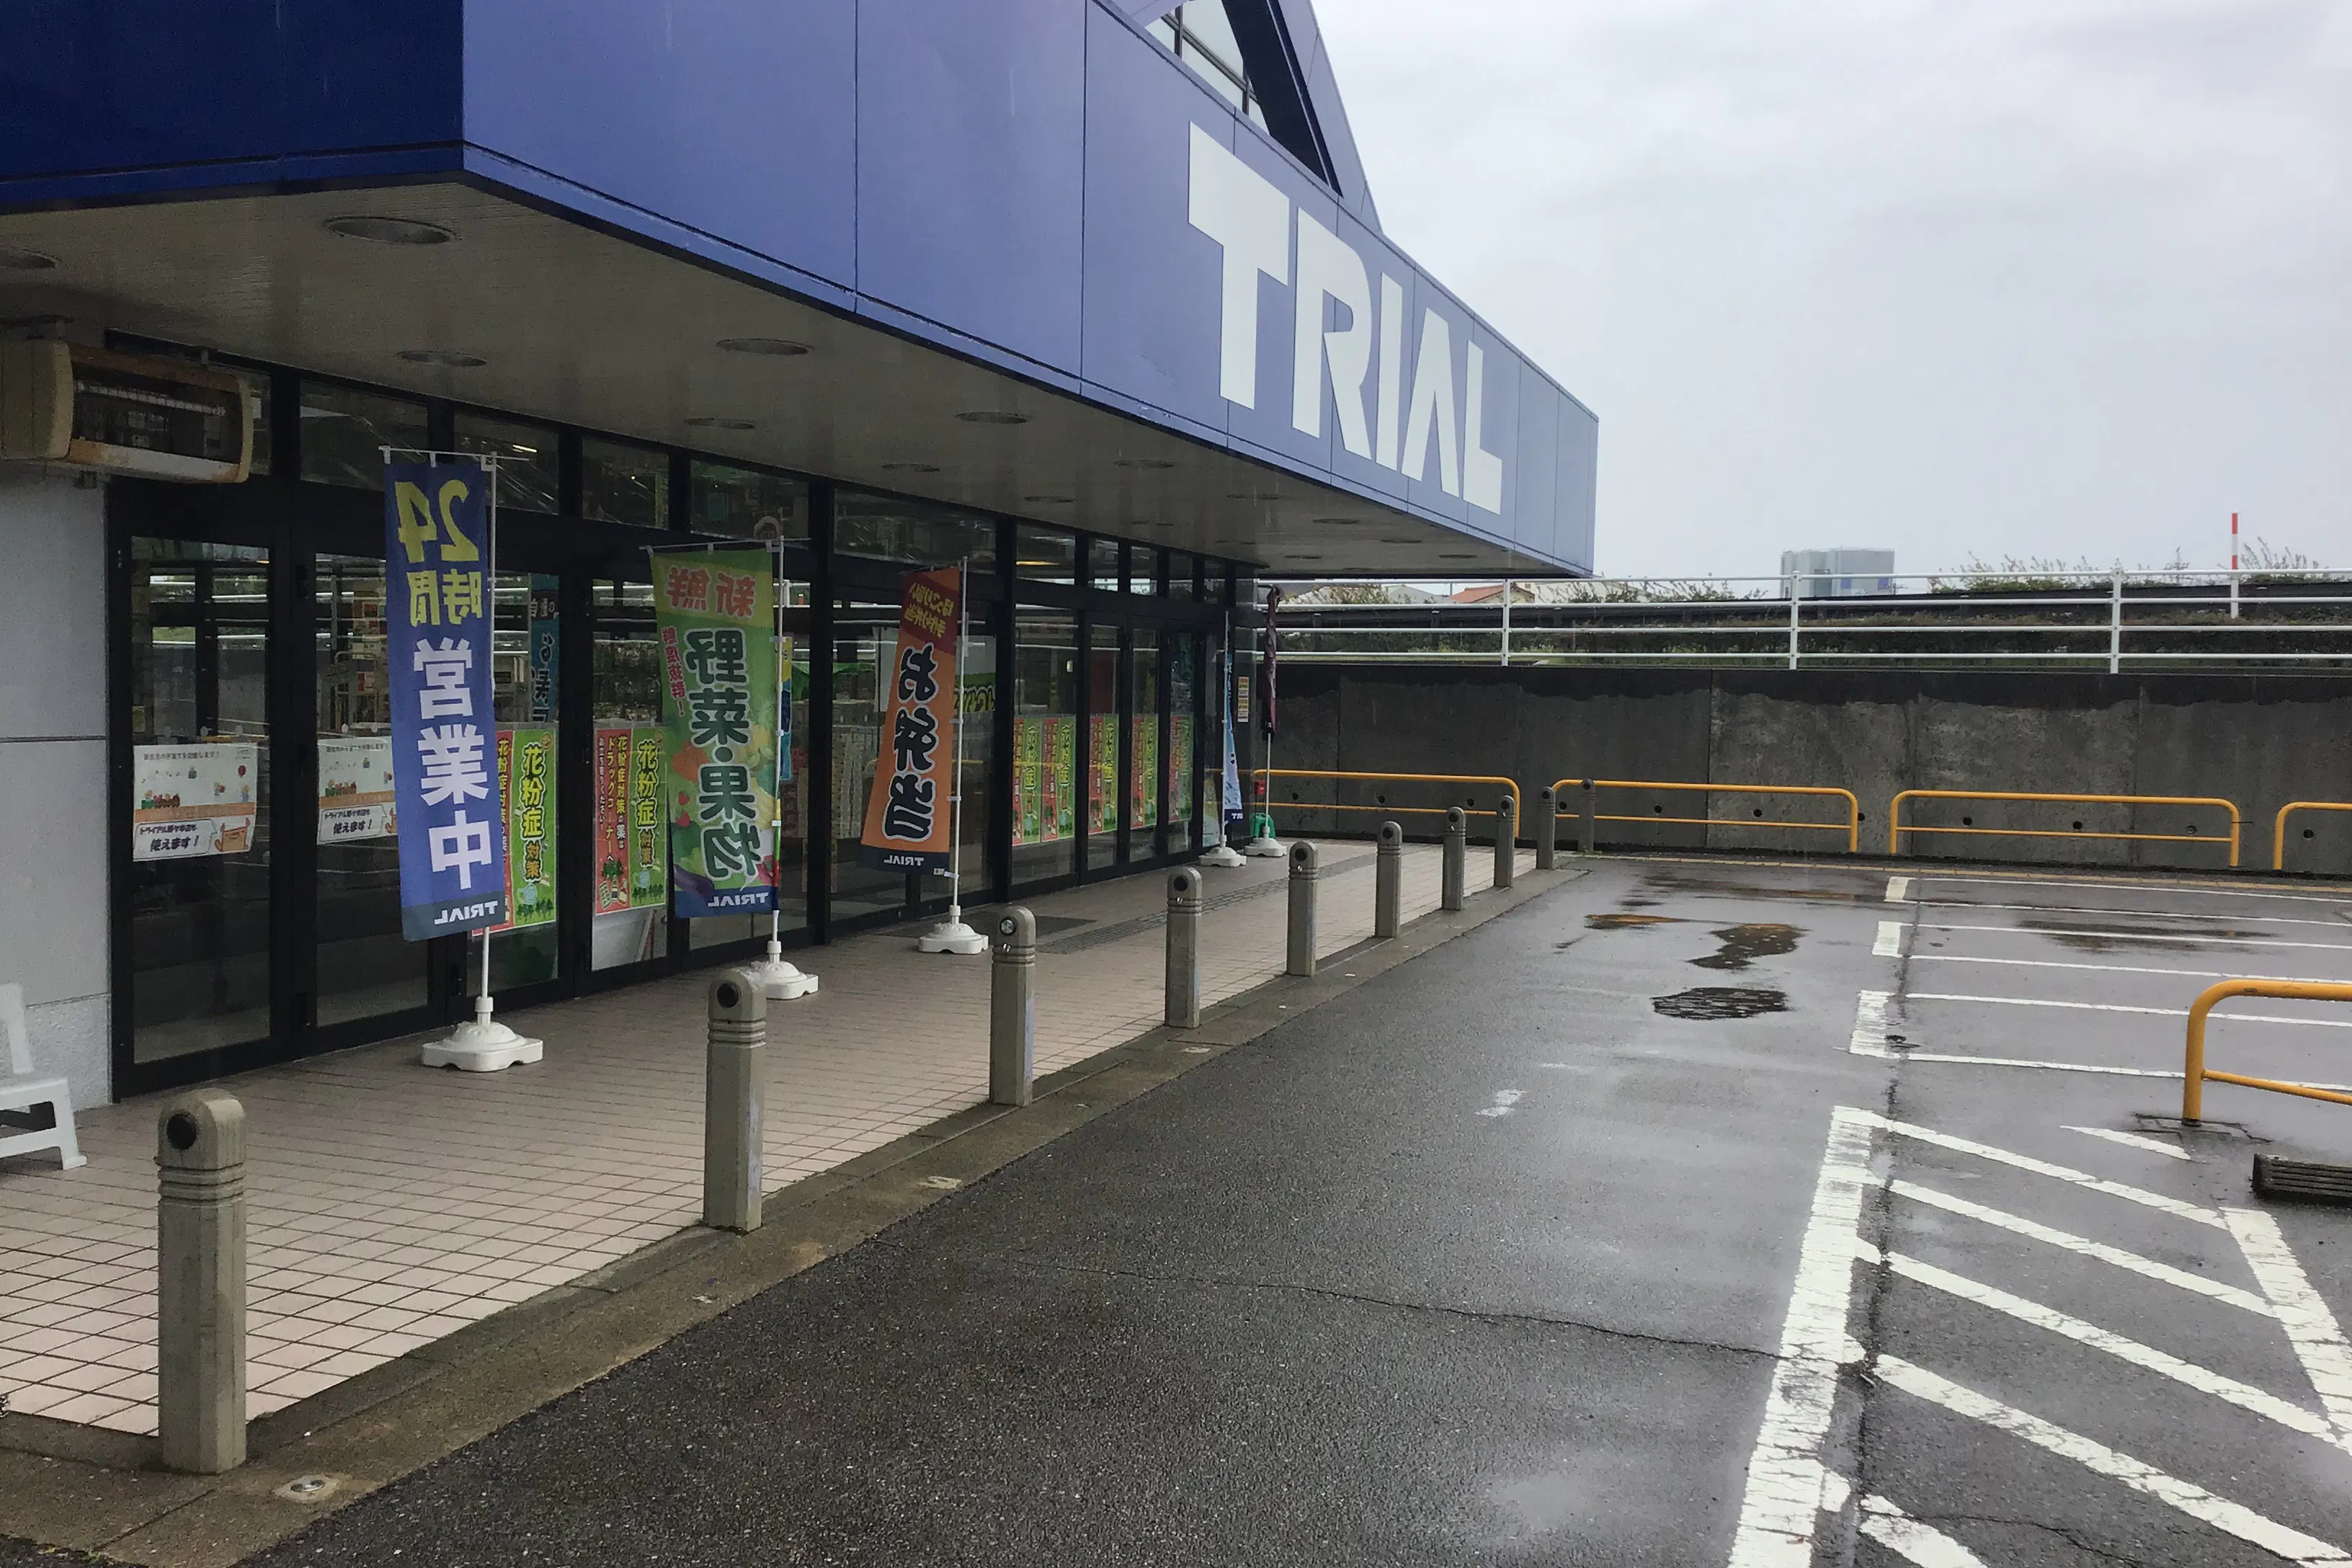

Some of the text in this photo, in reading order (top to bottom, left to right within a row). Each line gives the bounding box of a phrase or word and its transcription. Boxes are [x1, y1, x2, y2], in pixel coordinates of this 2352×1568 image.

[1188, 121, 1502, 514] TRIAL
[150, 835, 200, 852] 使えます！
[522, 743, 545, 881] 花粉症対策
[636, 740, 658, 866] 花粉症対策
